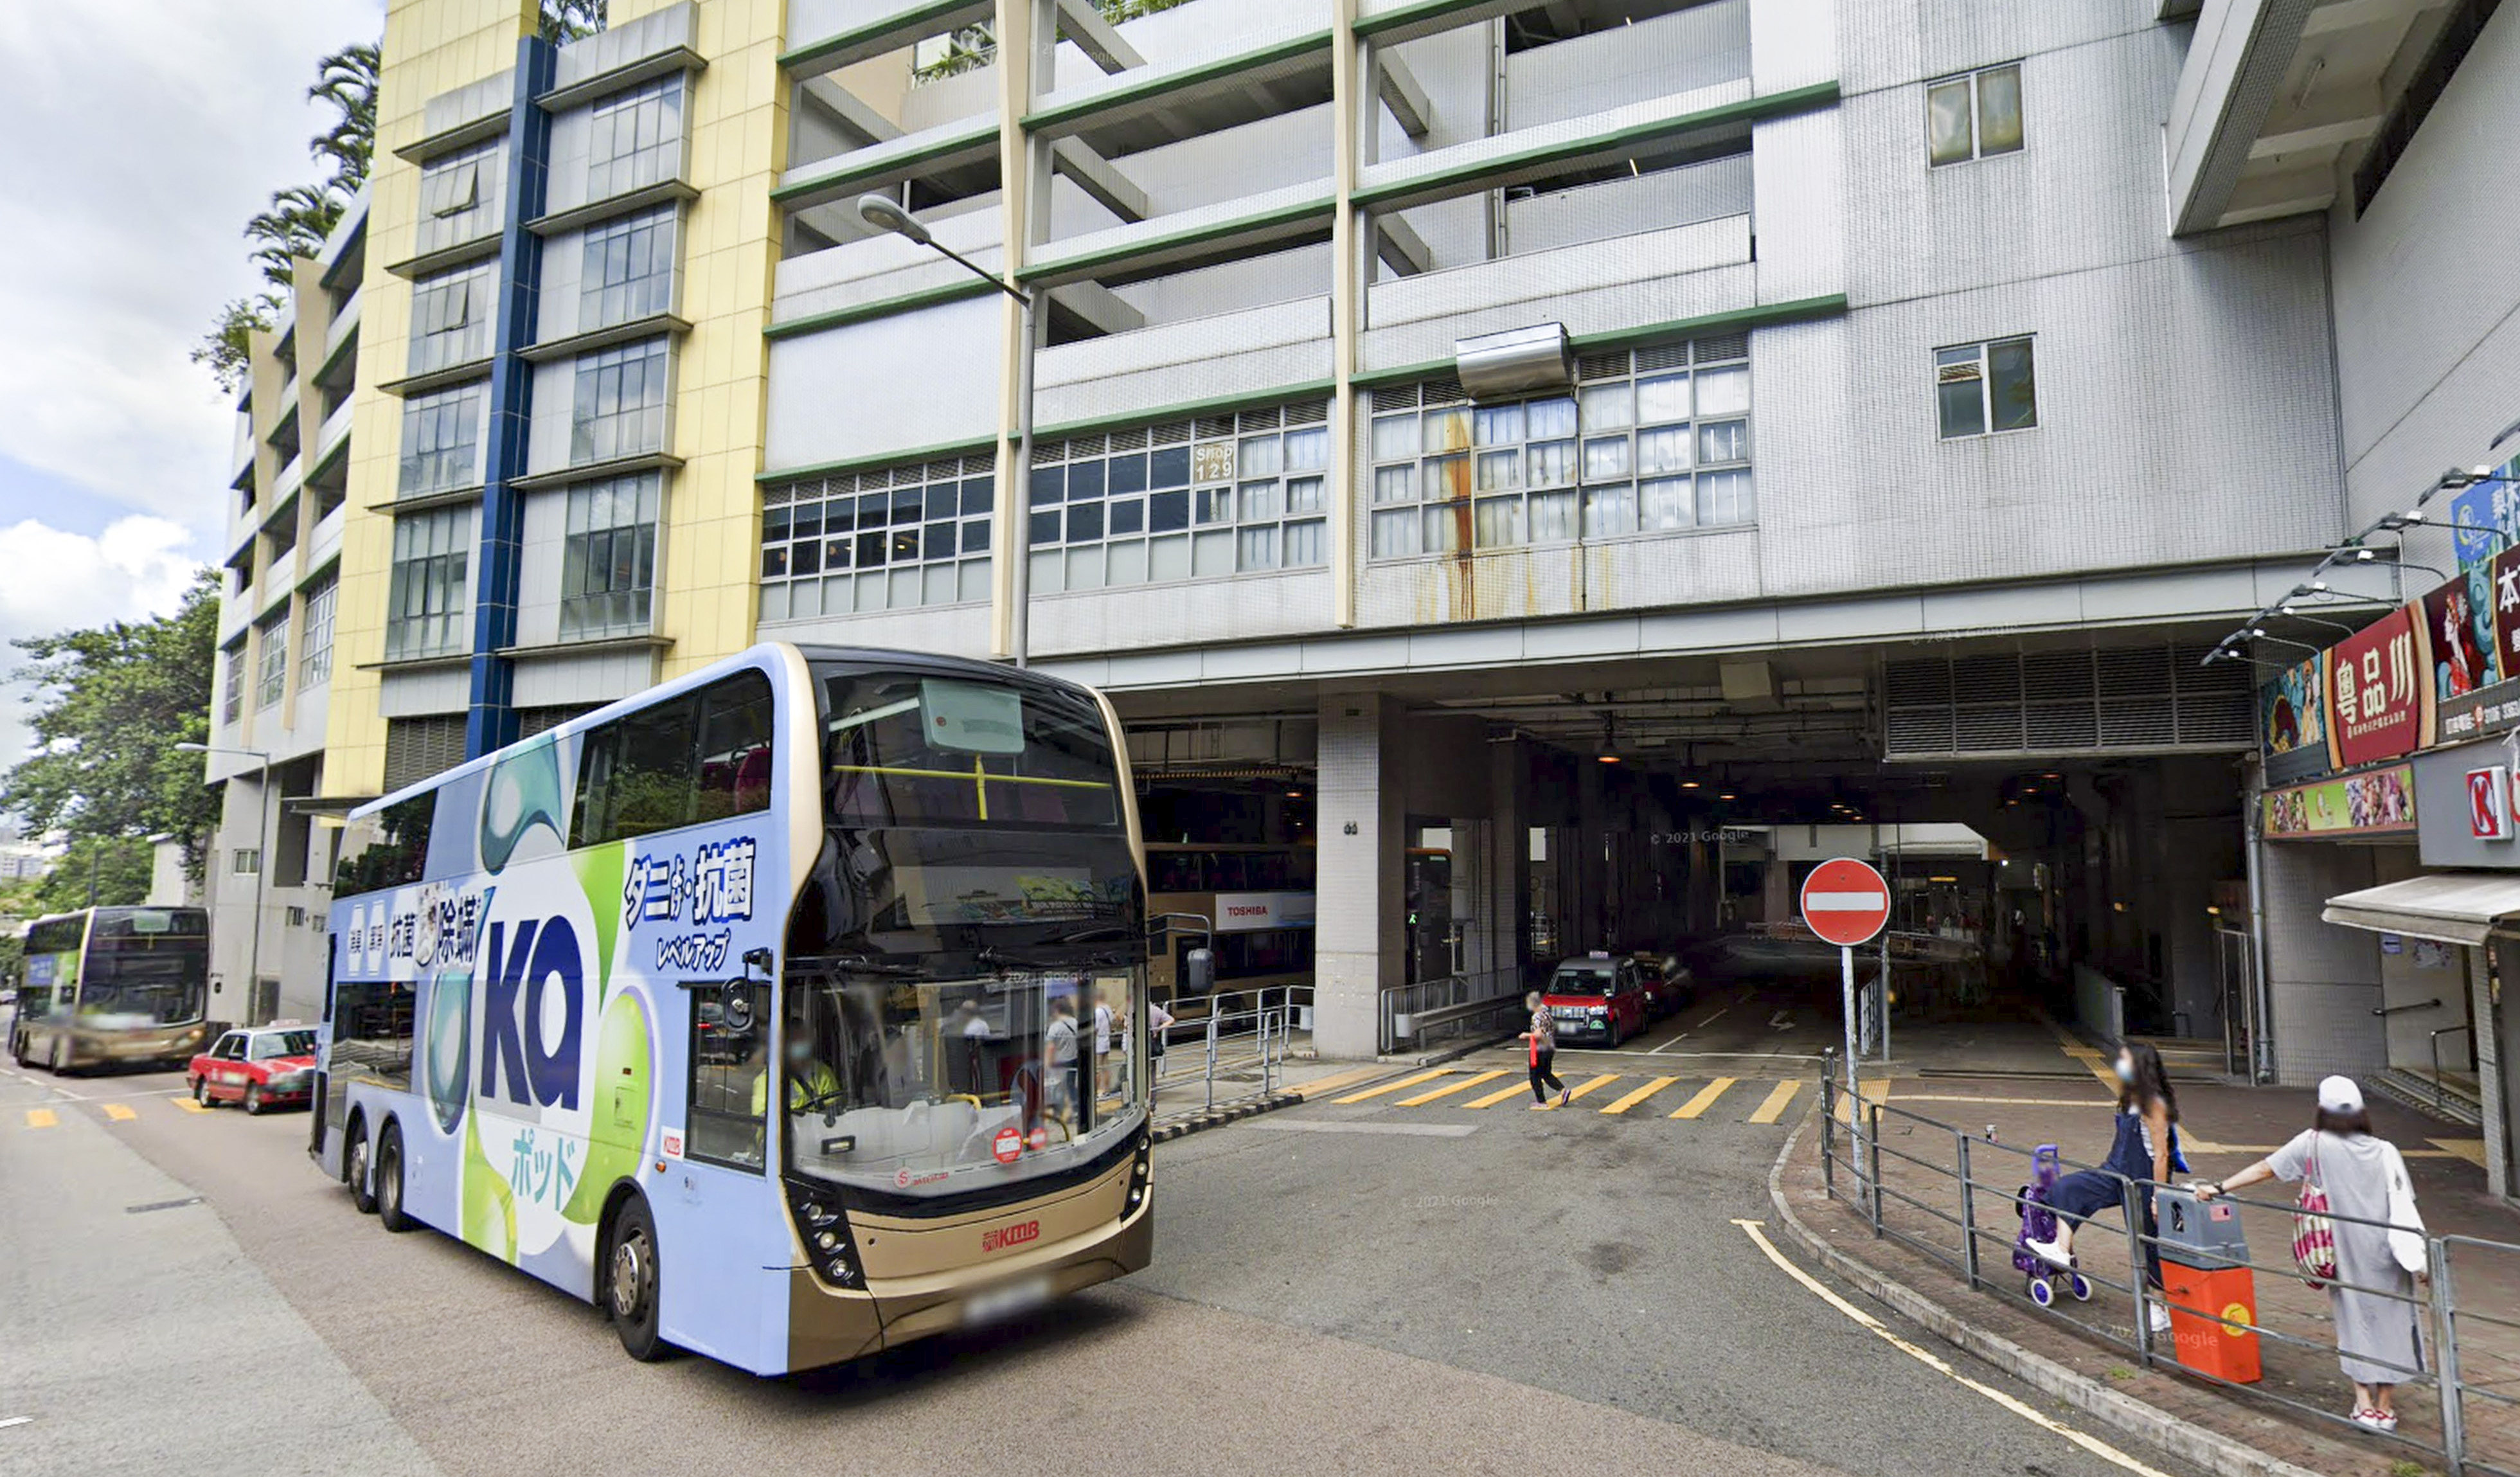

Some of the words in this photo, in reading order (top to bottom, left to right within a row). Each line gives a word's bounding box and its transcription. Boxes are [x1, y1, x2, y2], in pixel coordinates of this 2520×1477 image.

[1197, 461, 1233, 480] 129
[2497, 566, 2520, 613] 本
[1227, 906, 1268, 917] TOSHIBA
[656, 927, 731, 972] レベルアップ
[512, 1129, 575, 1212] ポッド
